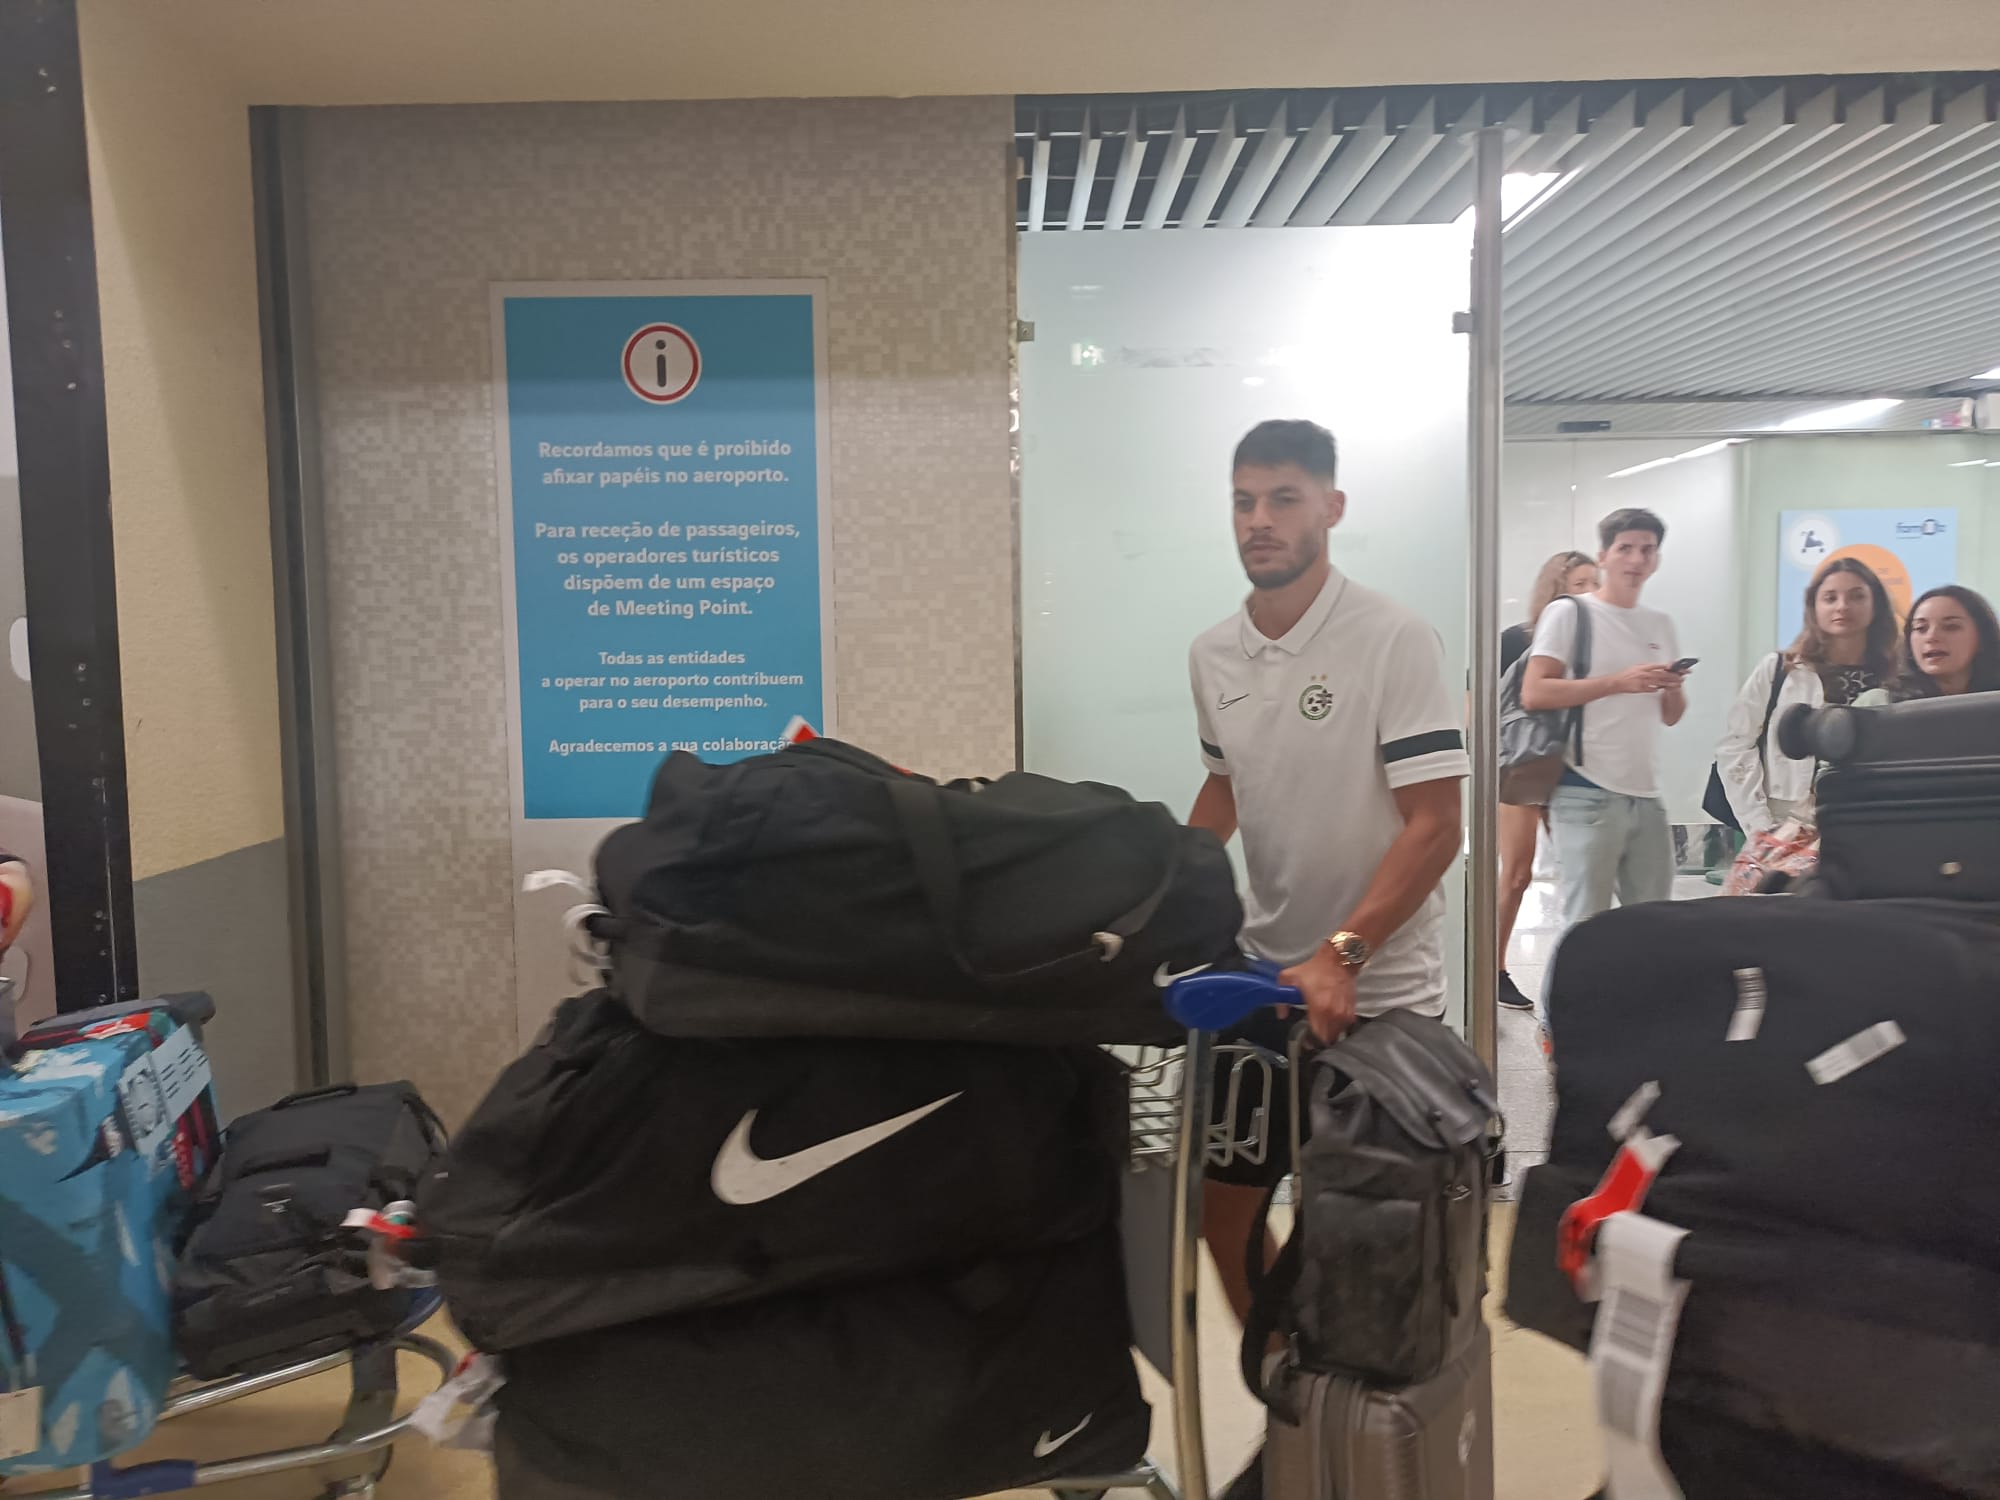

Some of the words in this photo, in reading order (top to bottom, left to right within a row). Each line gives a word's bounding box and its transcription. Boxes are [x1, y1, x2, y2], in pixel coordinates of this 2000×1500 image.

[538, 441, 654, 458] Recordamos
[657, 444, 693, 462] que
[697, 439, 709, 457] é
[713, 439, 792, 461] proibido
[542, 467, 595, 485] afixar
[599, 466, 661, 489] papéis
[665, 471, 689, 484] no
[692, 467, 789, 487] aeroporto.
[535, 522, 577, 539] Para
[581, 521, 654, 543] receção
[657, 520, 681, 538] de
[685, 519, 801, 542] passageiros,
[557, 551, 580, 565] os
[583, 547, 688, 569] operadores
[691, 546, 780, 563] turísticos
[563, 573, 644, 595] dispõem
[647, 573, 672, 590] de
[676, 577, 706, 589] um
[710, 576, 776, 594] espaço
[587, 599, 611, 617] de
[615, 599, 694, 620] Meeting
[699, 599, 753, 616] Point.
[598, 650, 644, 665] Todas
[646, 654, 665, 665] as
[668, 650, 746, 665] entidades
[541, 677, 551, 688] a
[554, 676, 606, 691] operar
[609, 676, 630, 687] no
[633, 673, 710, 690] aeroporto
[712, 671, 804, 686] contribuem
[579, 698, 614, 713] para
[617, 698, 628, 709] o
[630, 697, 659, 709] seu
[662, 693, 768, 712] desempenho.
[548, 738, 655, 757] Agradecemos
[657, 741, 668, 752] a
[671, 740, 698, 752] sua
